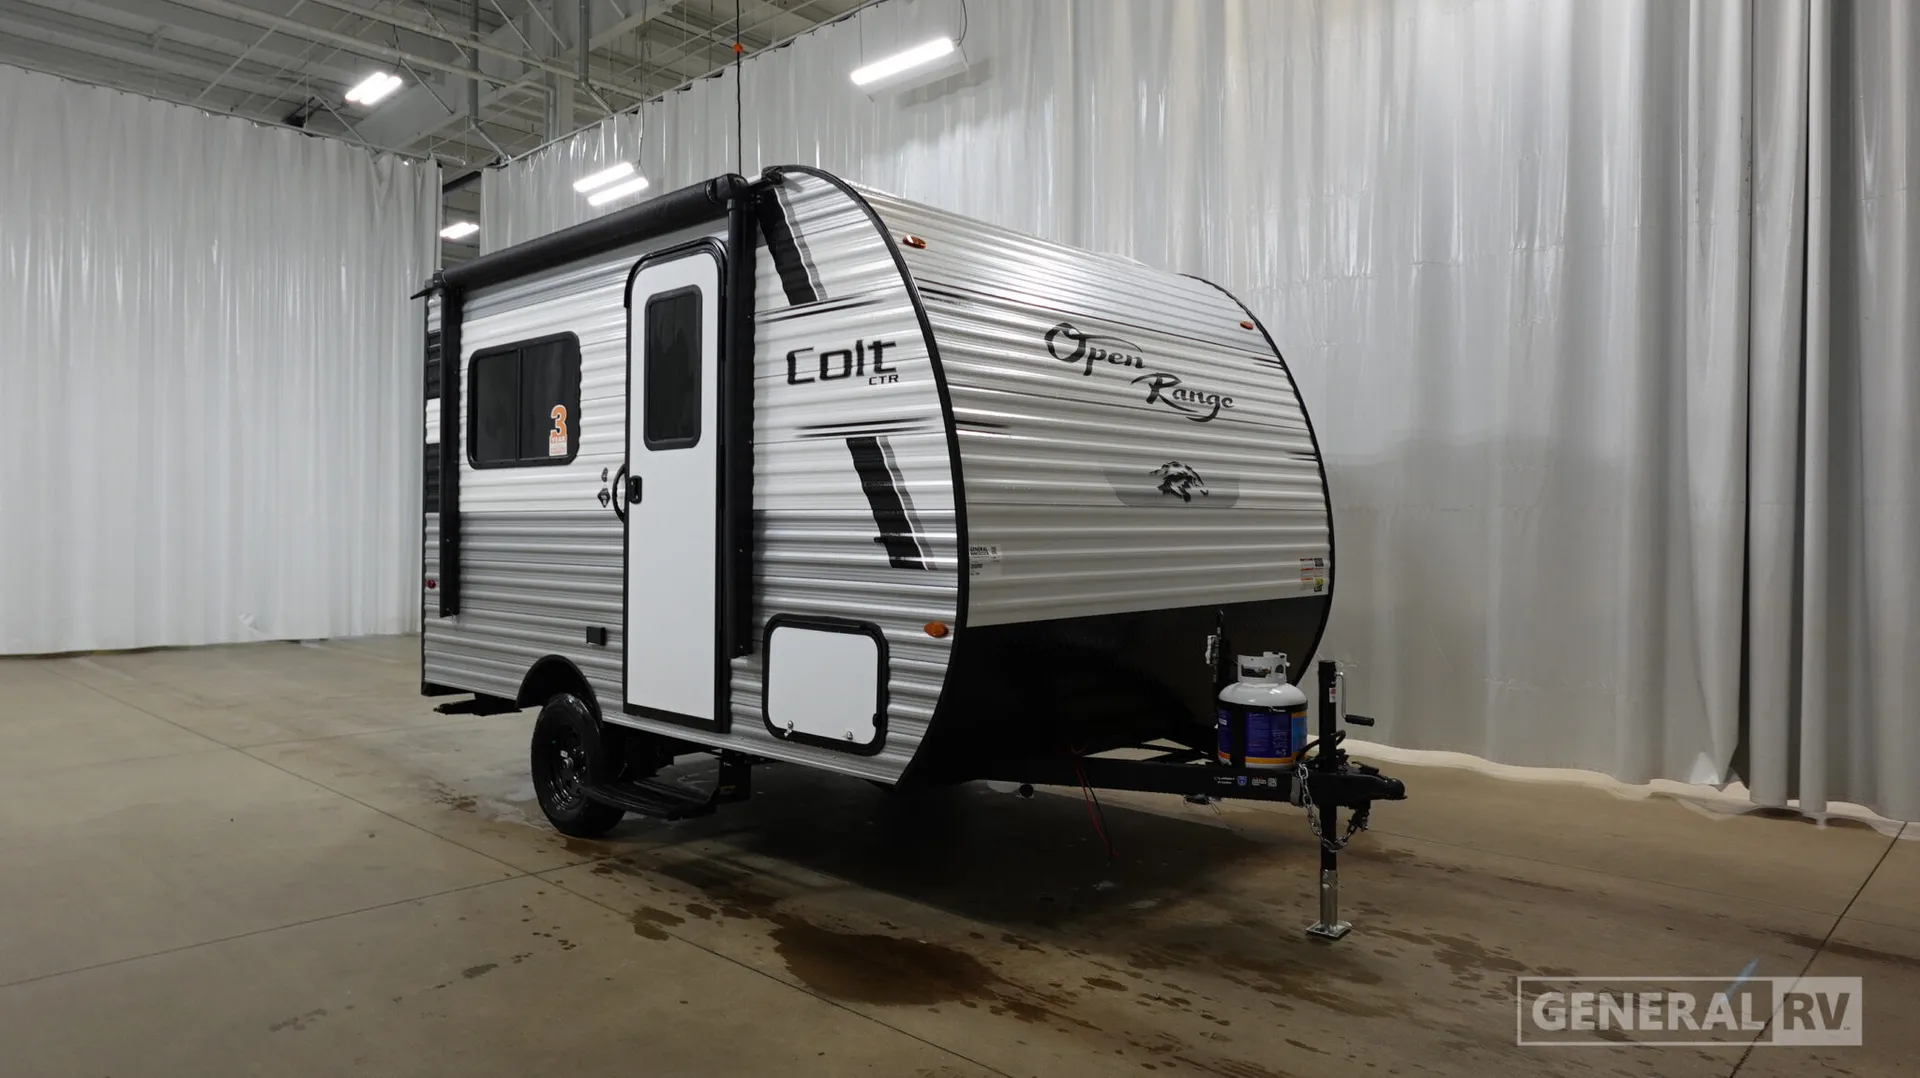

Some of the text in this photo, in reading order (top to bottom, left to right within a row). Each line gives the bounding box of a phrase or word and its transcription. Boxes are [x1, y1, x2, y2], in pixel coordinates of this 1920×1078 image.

[786, 339, 897, 385] Colt
[1044, 322, 1146, 376] Open
[868, 374, 899, 386] CTR
[1130, 372, 1235, 422] Range
[551, 404, 567, 437] 3
